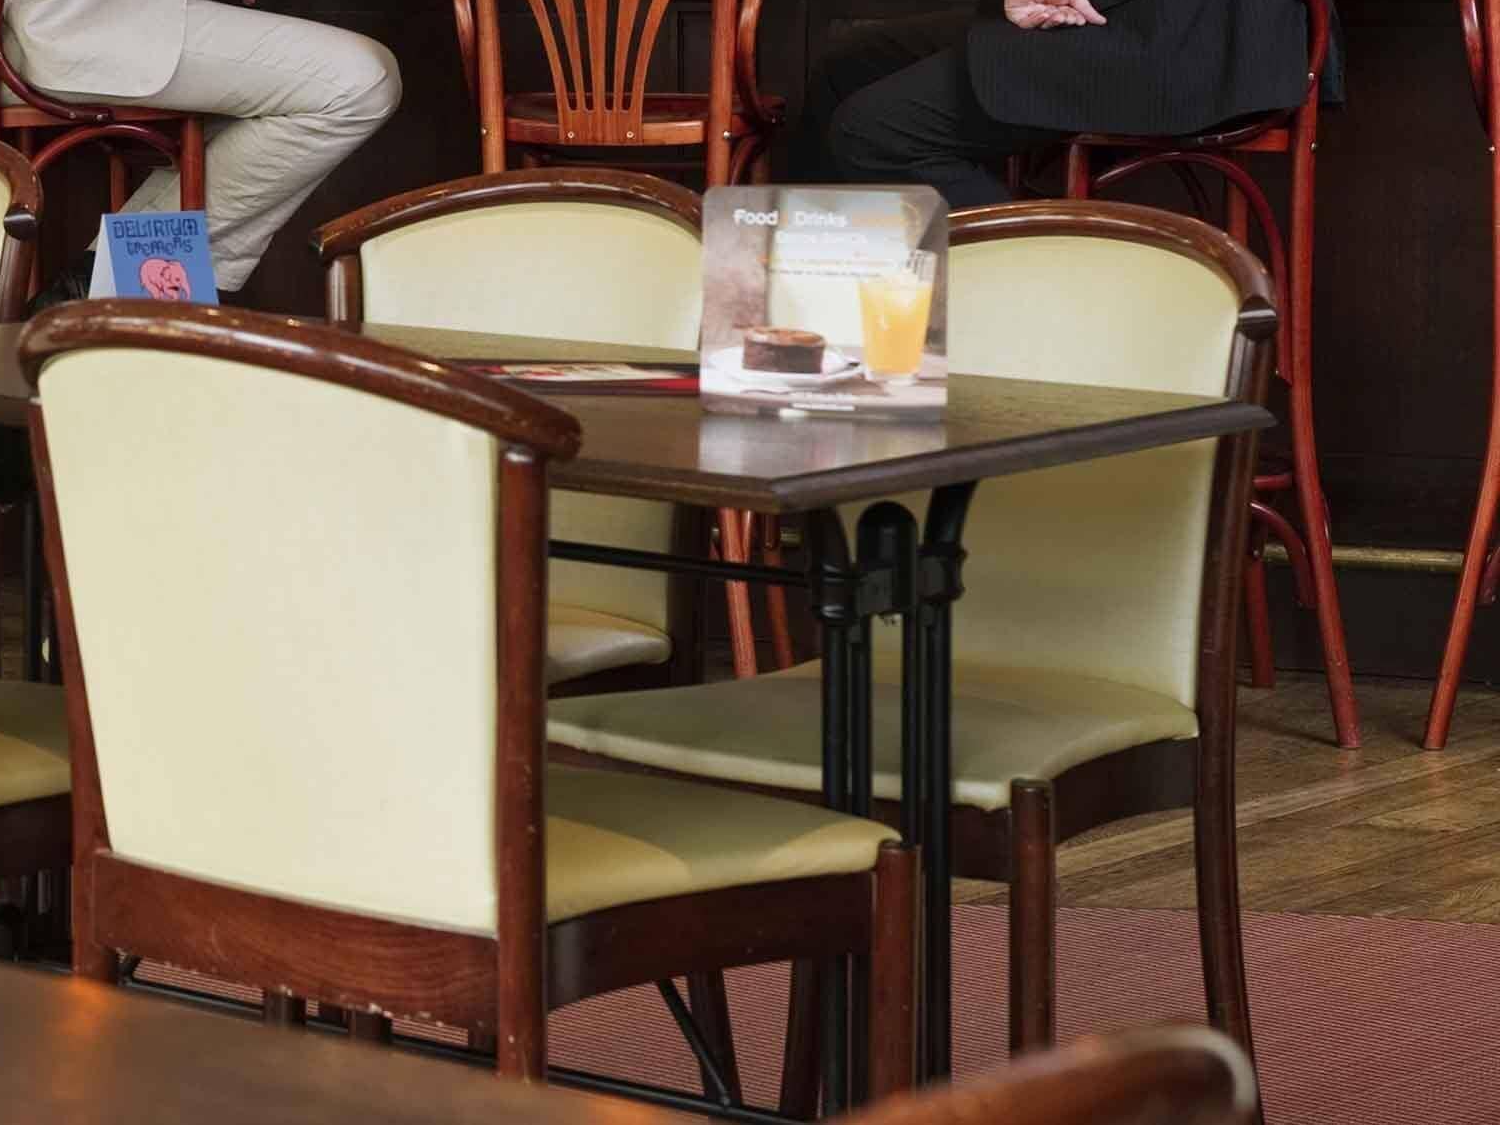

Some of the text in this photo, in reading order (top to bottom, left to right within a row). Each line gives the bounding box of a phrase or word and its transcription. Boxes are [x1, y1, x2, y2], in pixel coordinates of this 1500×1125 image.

[733, 208, 780, 225] Food
[794, 210, 848, 227] Drinks
[112, 218, 199, 238] DELIRIUM
